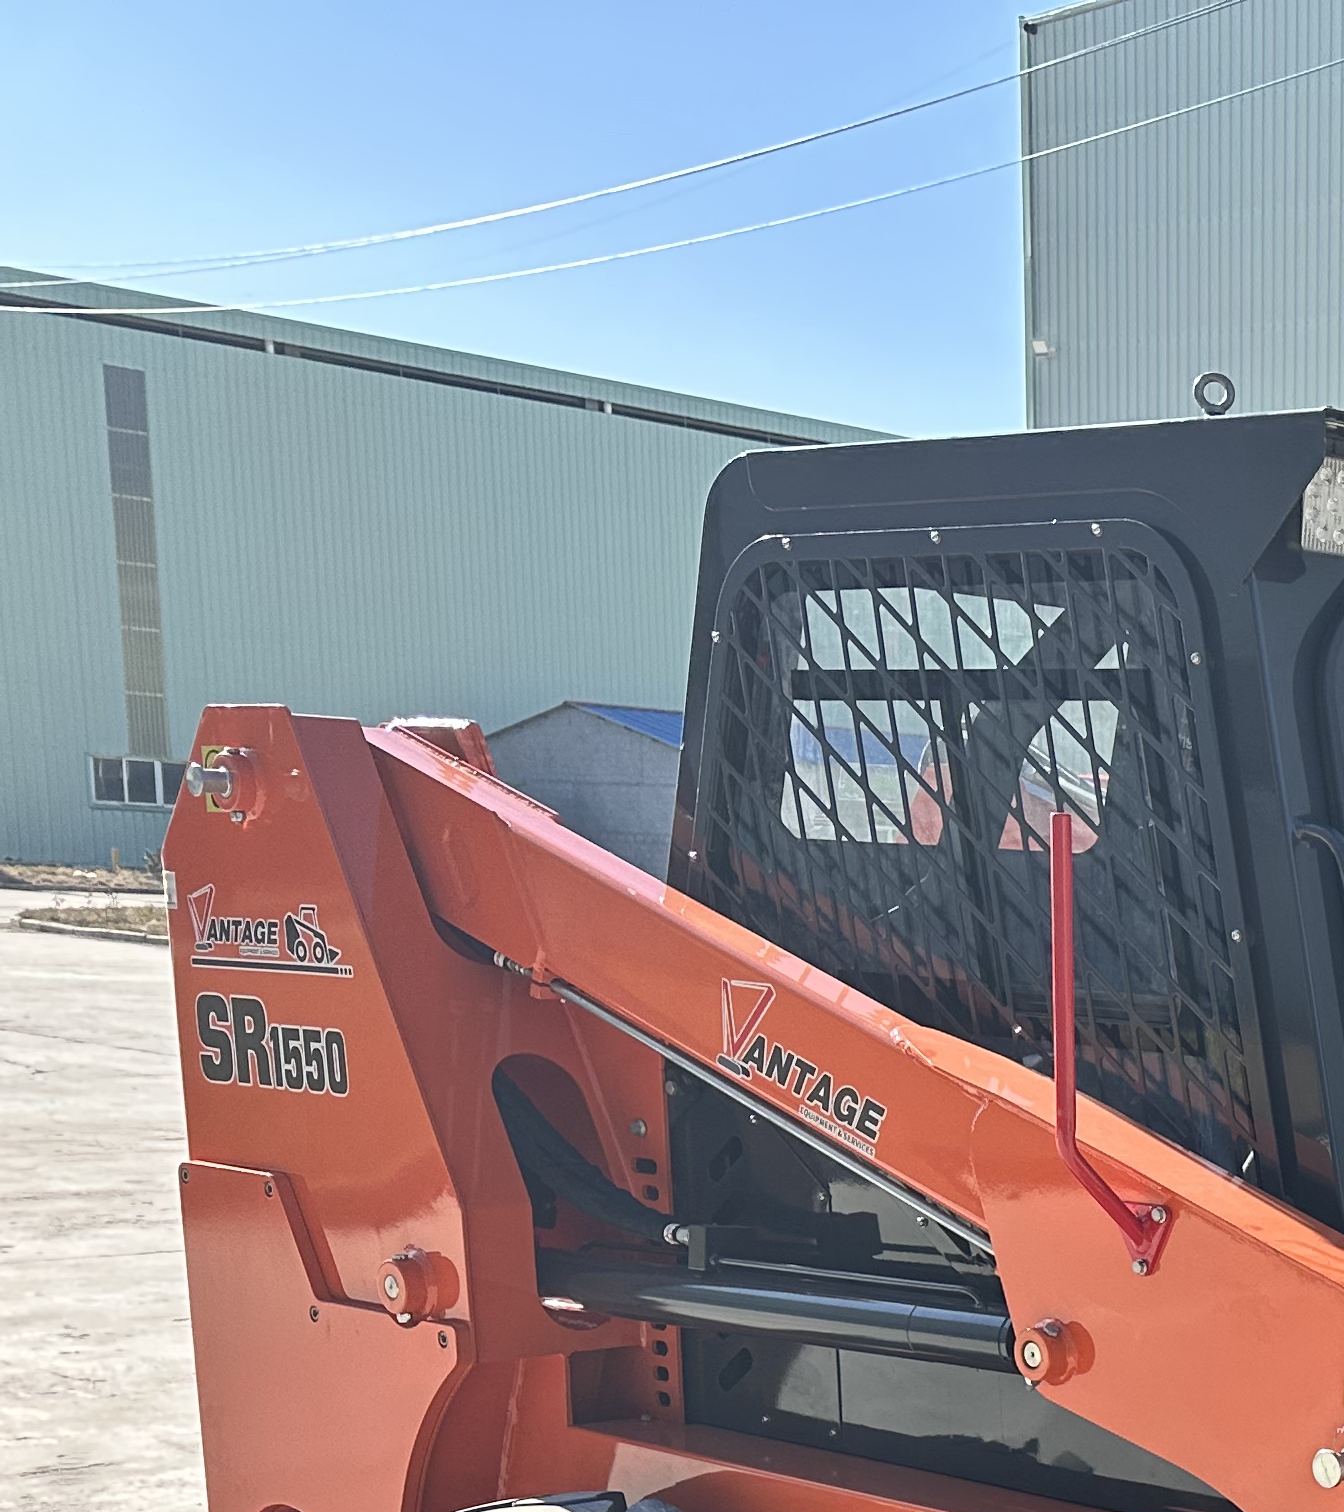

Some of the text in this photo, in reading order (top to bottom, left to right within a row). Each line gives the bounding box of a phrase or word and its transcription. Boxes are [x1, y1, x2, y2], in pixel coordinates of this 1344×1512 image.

[187, 884, 279, 951] VANTAGE
[196, 993, 349, 1097] SR1550
[716, 978, 888, 1143] VANTAGE
